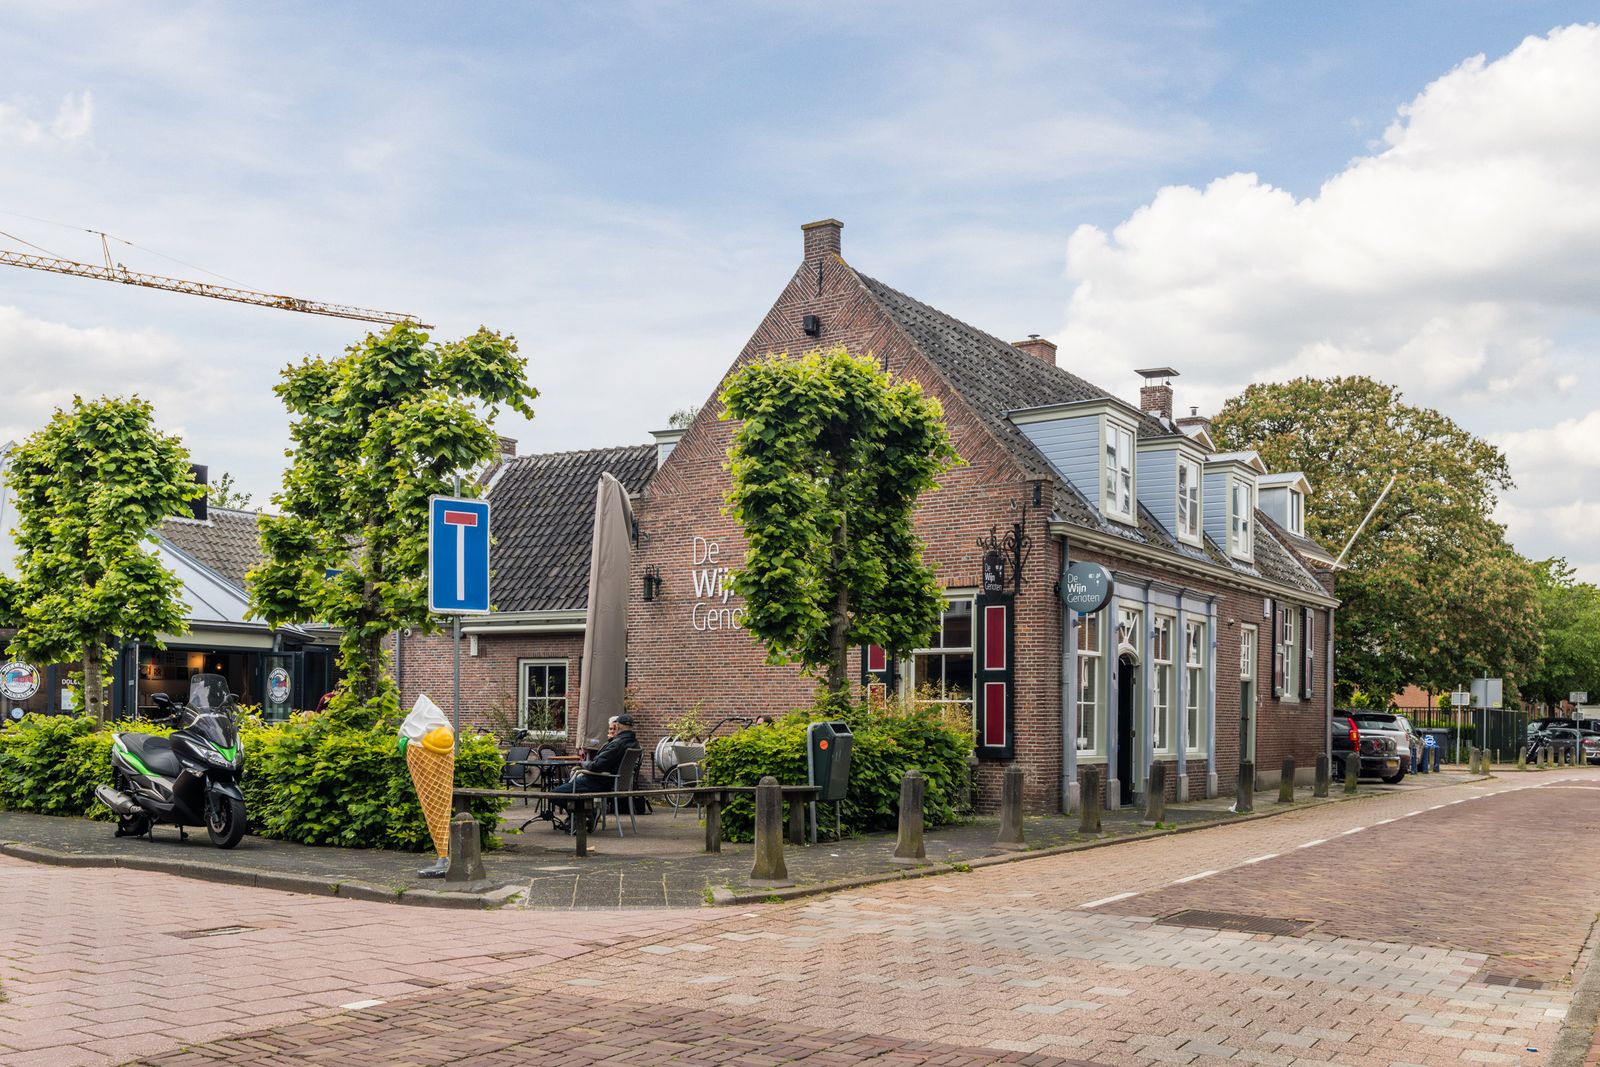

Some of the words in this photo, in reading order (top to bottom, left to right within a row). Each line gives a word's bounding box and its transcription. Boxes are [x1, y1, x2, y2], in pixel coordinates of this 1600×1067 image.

[693, 537, 719, 565] De
[985, 563, 991, 572] De
[985, 573, 995, 583] Wijn
[1067, 574, 1078, 583] De
[985, 582, 1002, 591] Genoten
[1067, 583, 1087, 594] Wijn
[1067, 593, 1100, 603] Genoten
[692, 602, 747, 631] Geno
